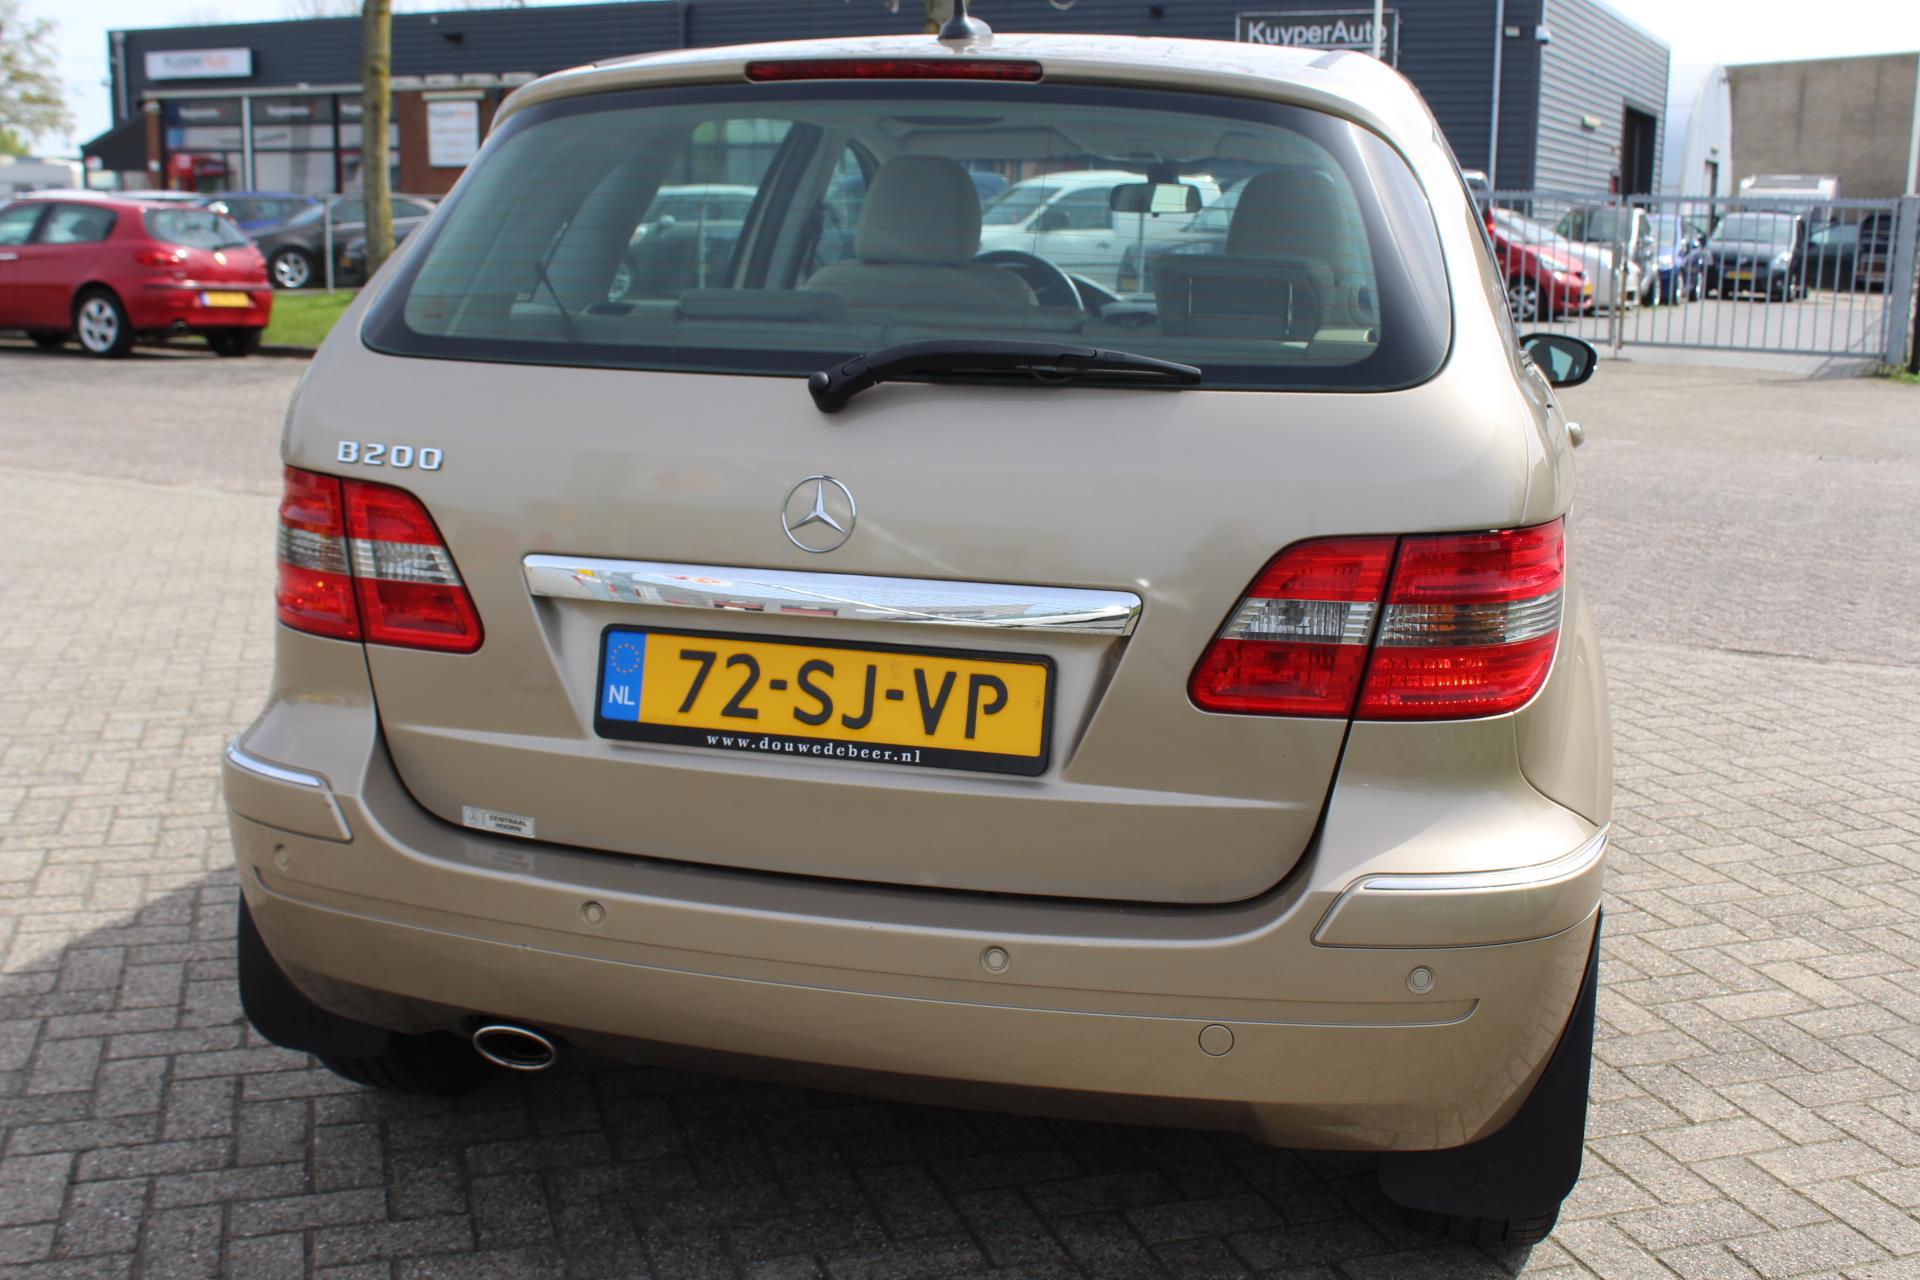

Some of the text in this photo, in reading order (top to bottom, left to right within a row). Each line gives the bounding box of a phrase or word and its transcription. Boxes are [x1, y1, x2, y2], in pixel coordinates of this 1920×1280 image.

[337, 440, 444, 470] B200
[608, 684, 635, 706] NL
[677, 648, 1009, 740] 72-SJ-VP
[706, 734, 922, 763] www.douwedebeer.nl
